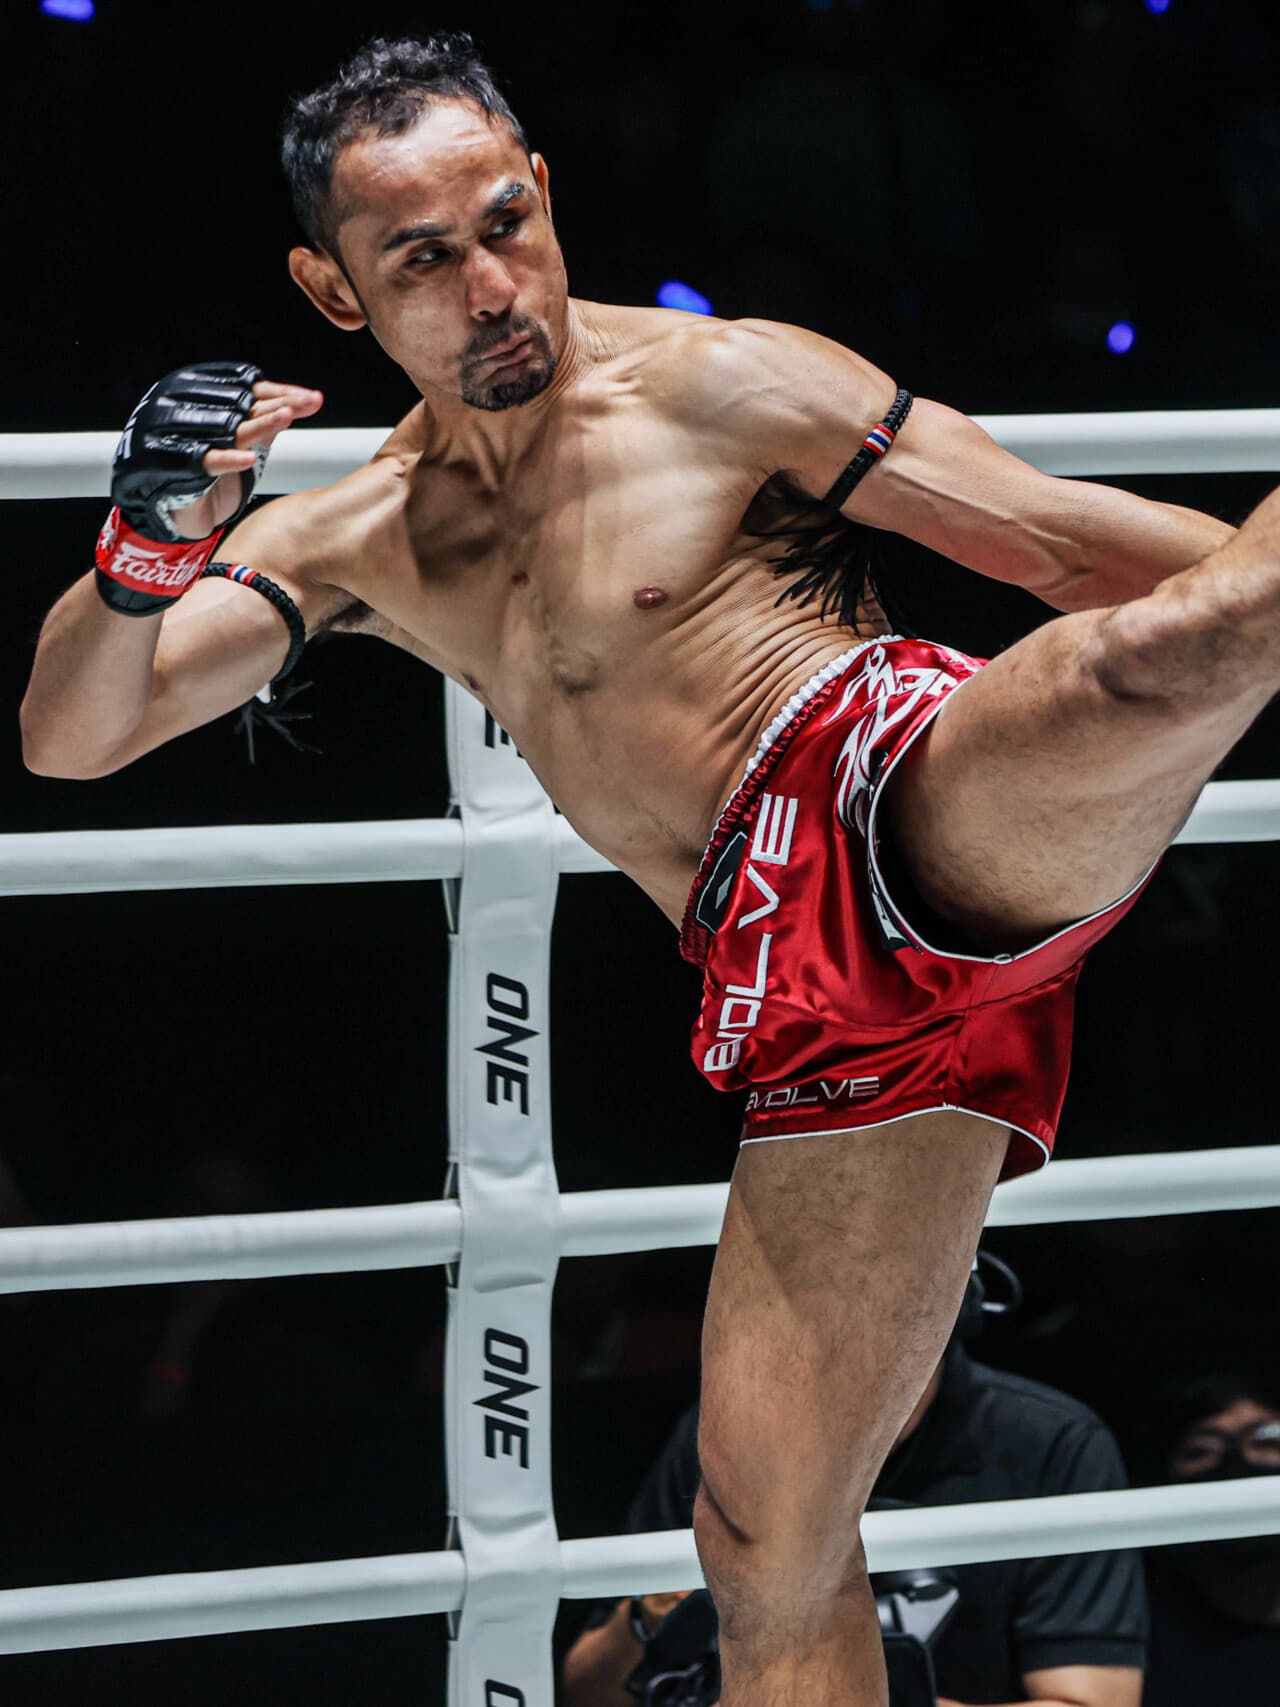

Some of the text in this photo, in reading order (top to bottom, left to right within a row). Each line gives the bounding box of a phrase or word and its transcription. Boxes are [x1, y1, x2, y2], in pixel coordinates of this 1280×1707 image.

[704, 793, 799, 1072] EVOLVE
[475, 973, 540, 1115] ONE
[745, 1076, 880, 1112] EVOLVE
[473, 1328, 540, 1468] ONE
